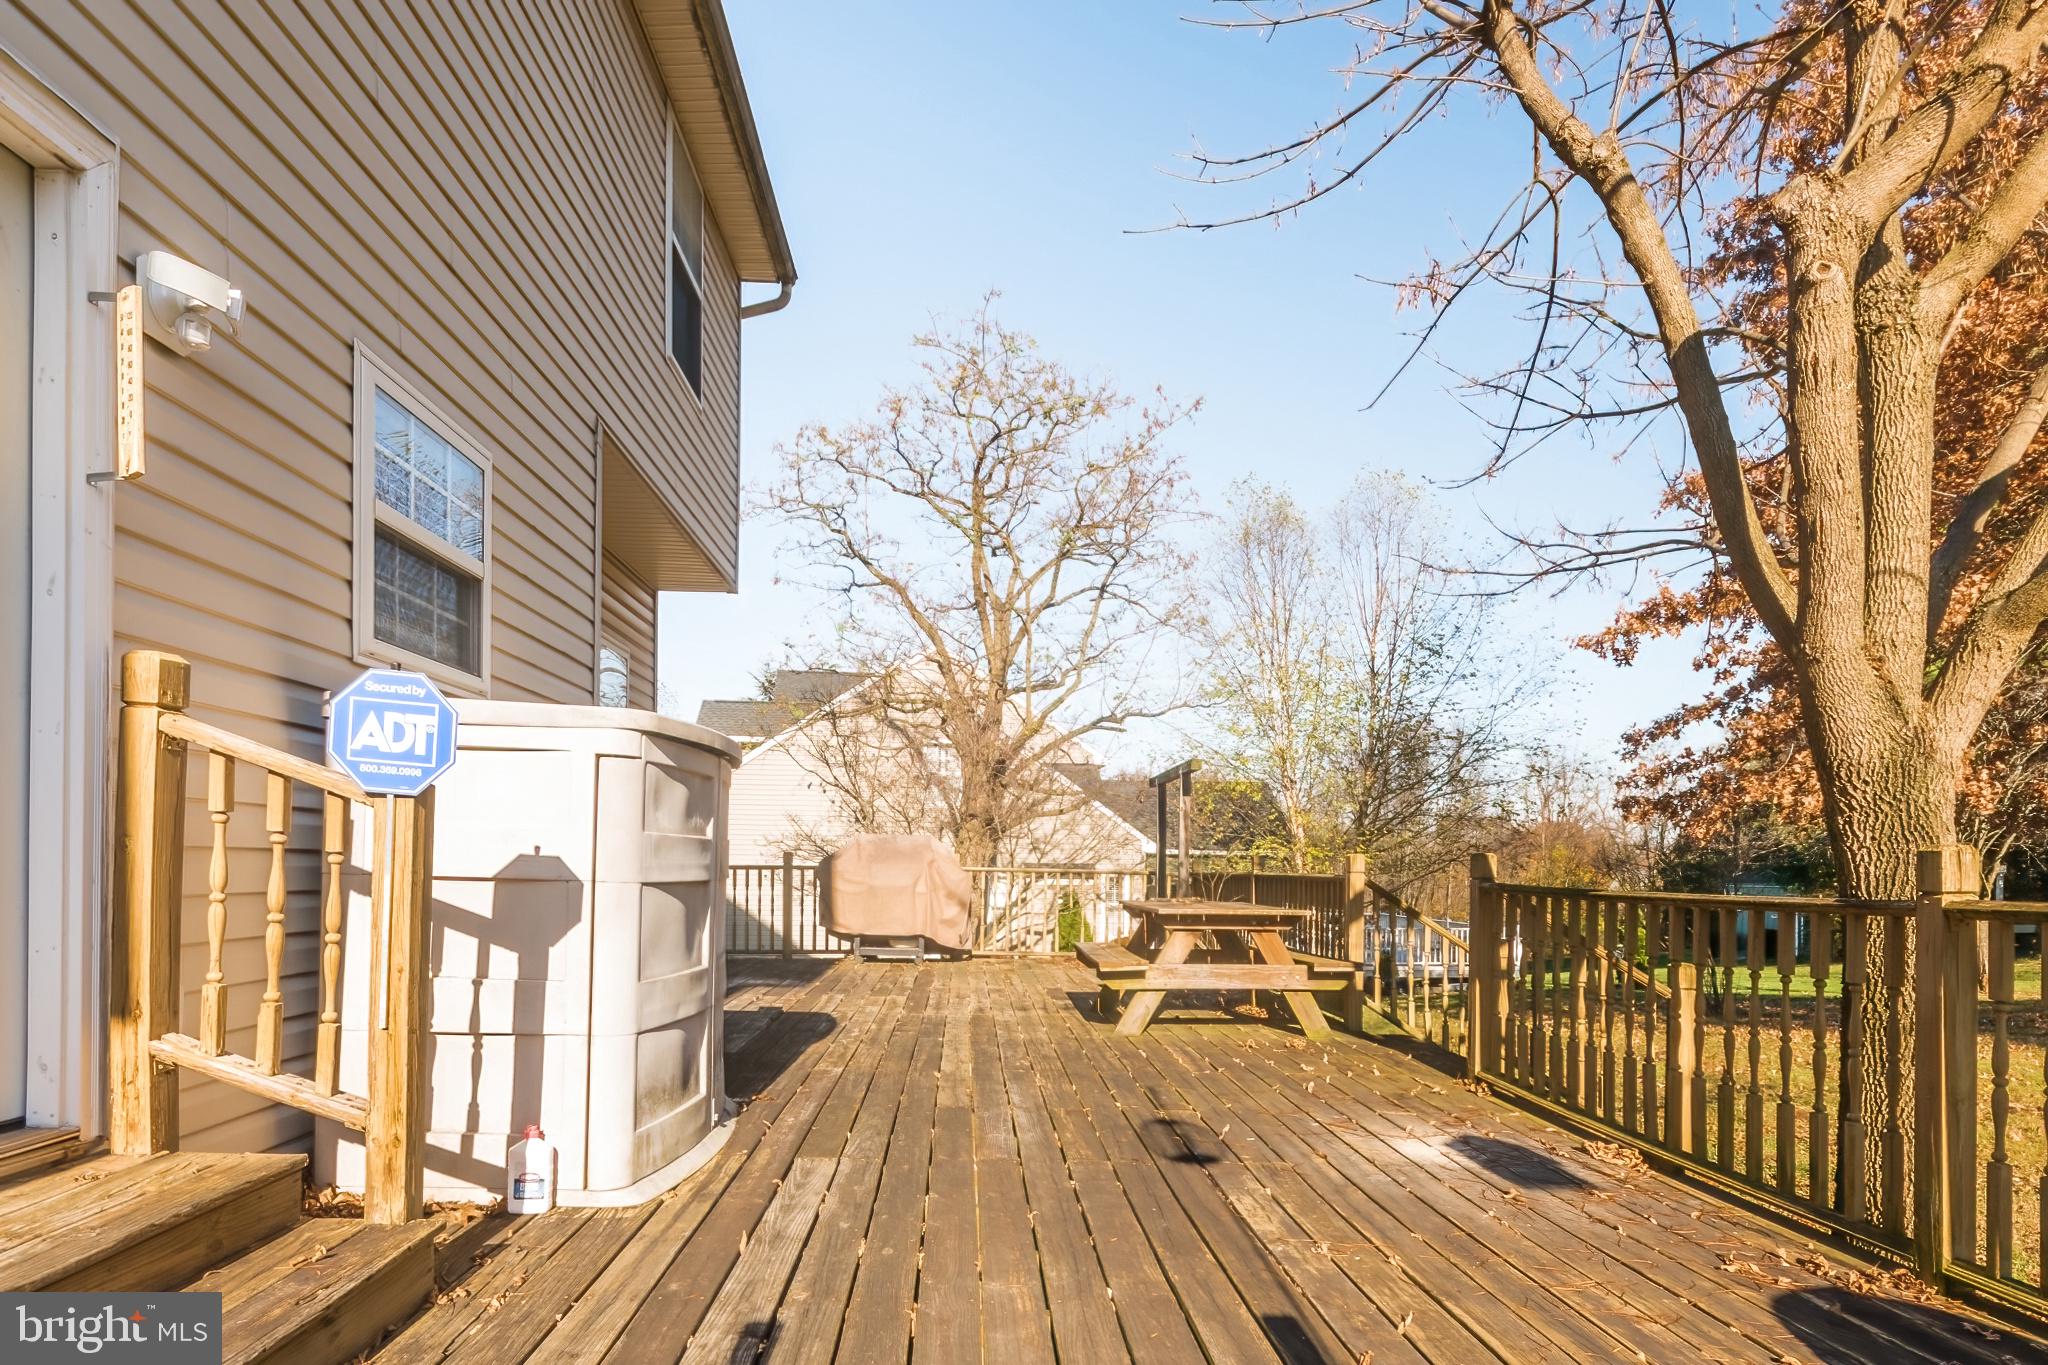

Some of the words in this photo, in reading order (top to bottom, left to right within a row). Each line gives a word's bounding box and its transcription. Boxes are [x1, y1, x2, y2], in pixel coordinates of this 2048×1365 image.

[364, 680, 411, 695] Secured
[412, 685, 426, 698] by
[350, 710, 436, 756] ADT
